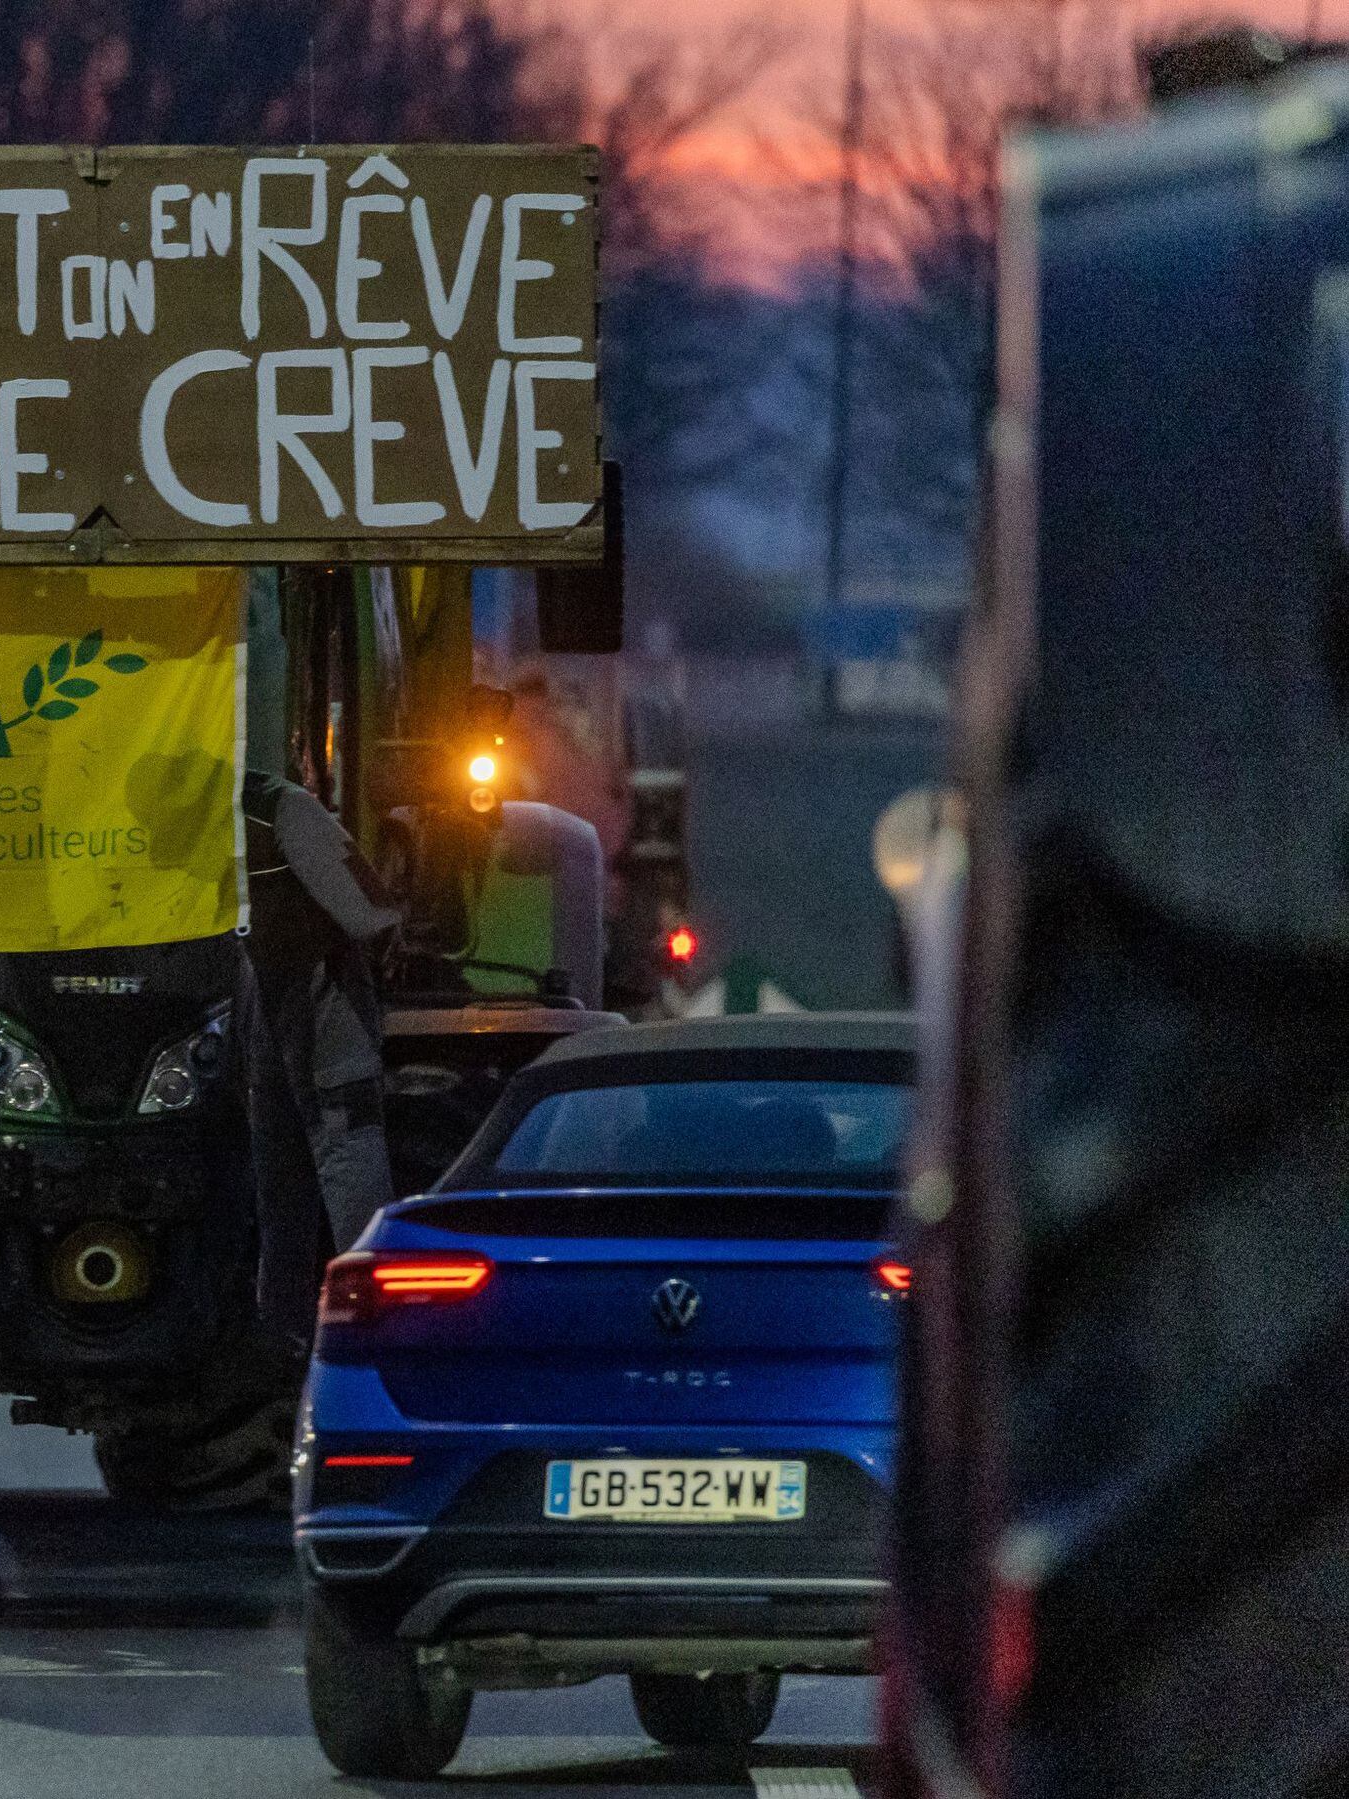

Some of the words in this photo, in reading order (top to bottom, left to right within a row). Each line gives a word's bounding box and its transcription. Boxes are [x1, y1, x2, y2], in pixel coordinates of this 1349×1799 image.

[62, 254, 155, 339] ON
[150, 184, 232, 259] EN
[241, 155, 586, 353] RÊVE
[140, 348, 595, 529] CREVE
[580, 1470, 771, 1507] GB-532-WW
